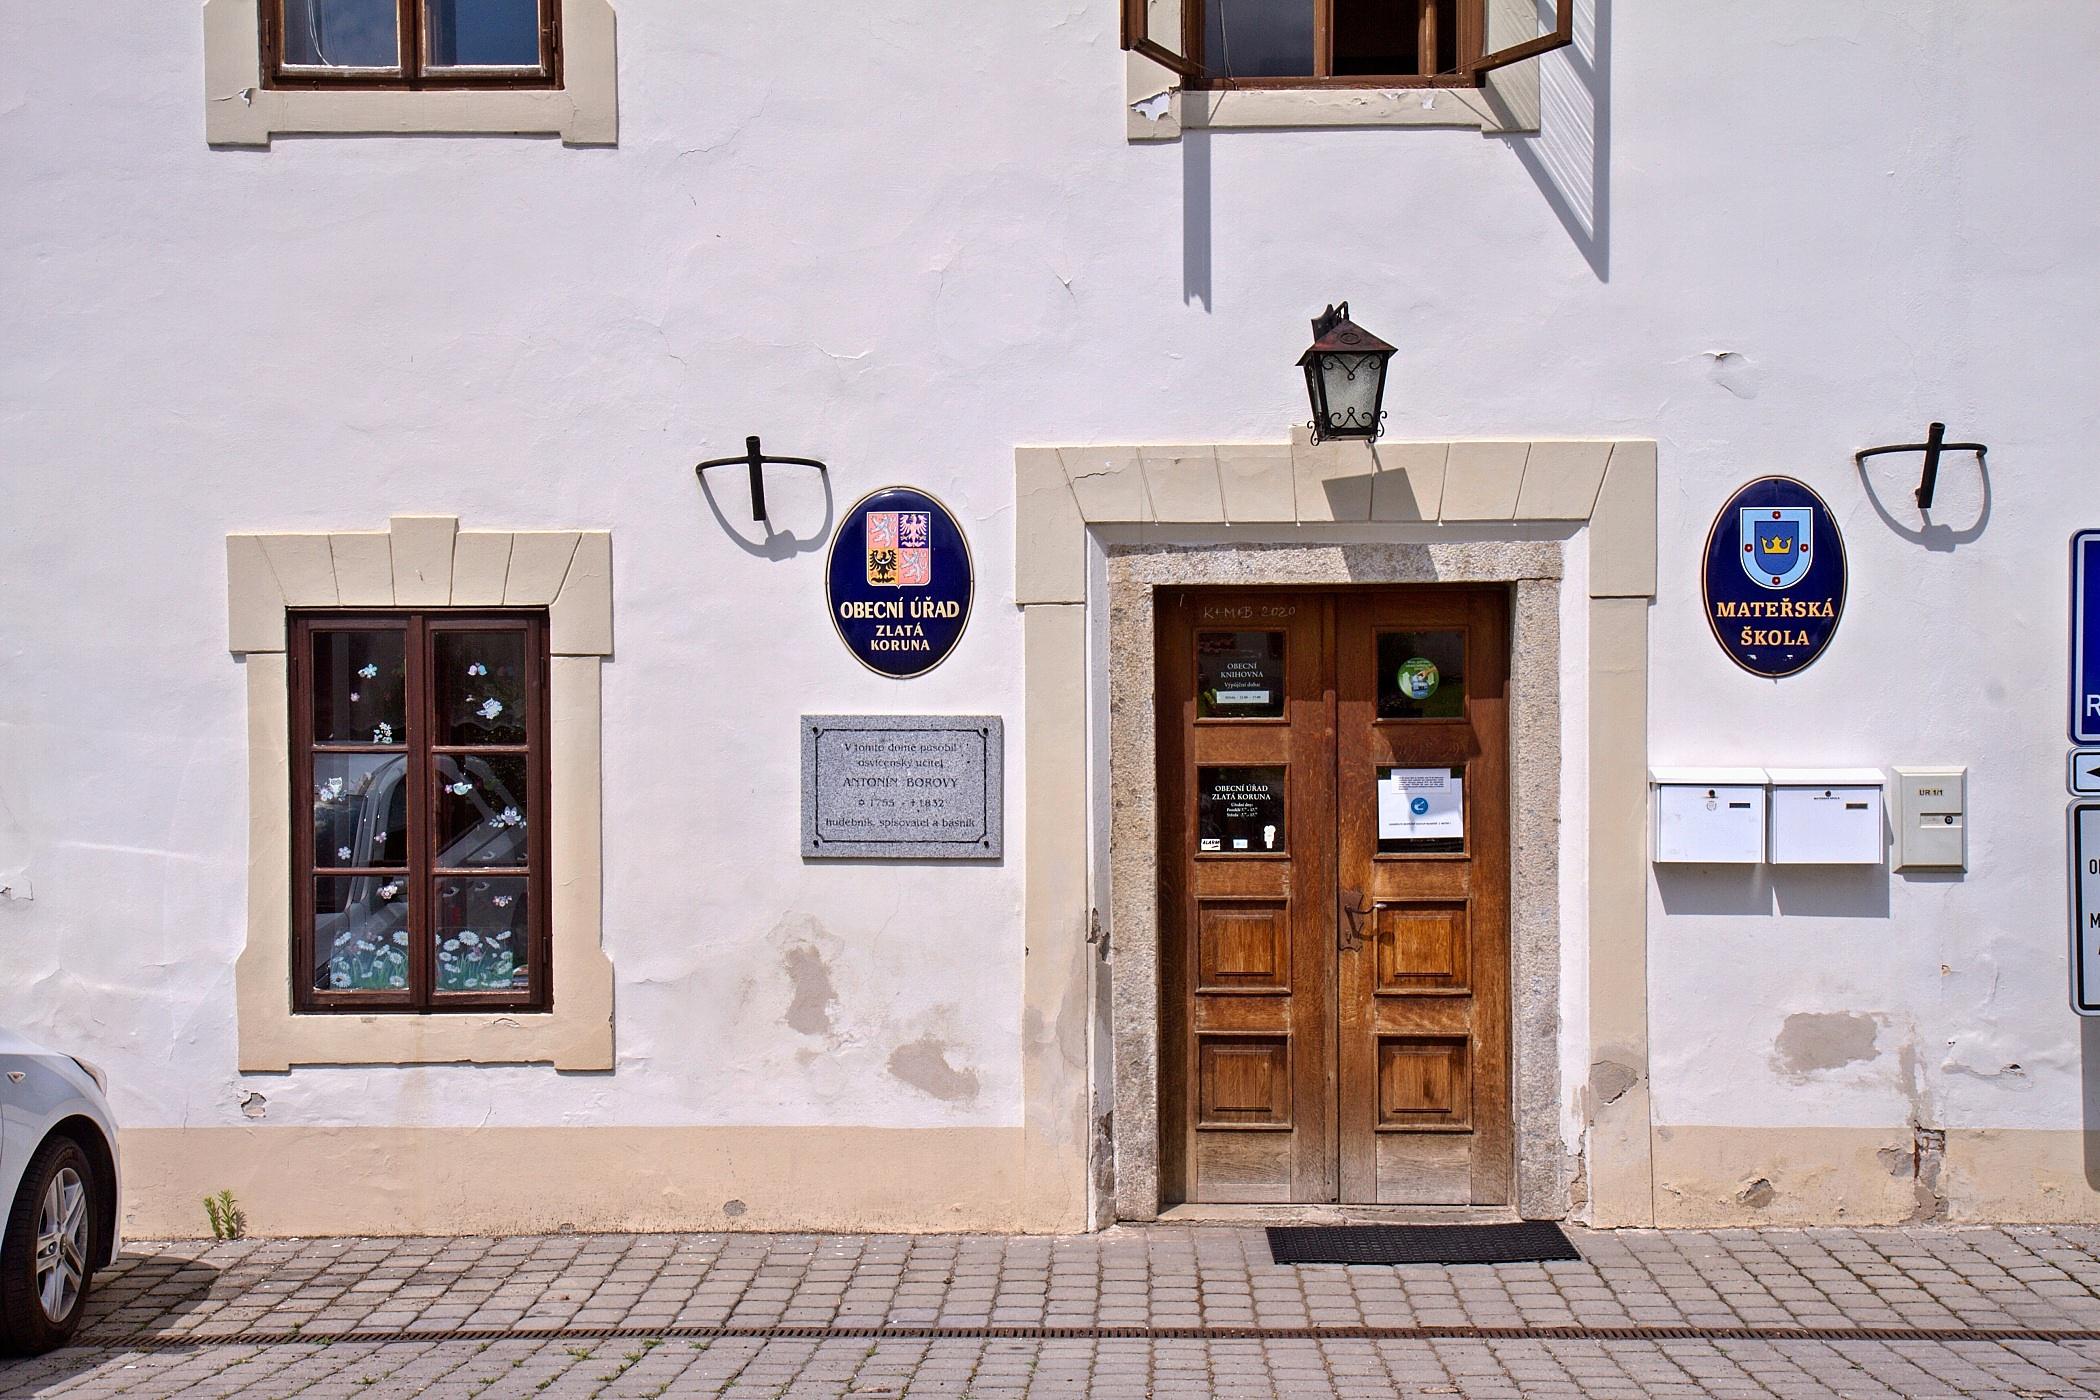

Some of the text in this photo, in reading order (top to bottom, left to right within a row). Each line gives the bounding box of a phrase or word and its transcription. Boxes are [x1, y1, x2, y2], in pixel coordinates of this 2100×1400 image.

[840, 596, 960, 619] OBECNÍ ÚŘAD
[1261, 606, 1296, 617] 2020
[1716, 598, 1834, 617] MATEŘSKÁ
[876, 622, 923, 637] ZLATÁ
[1741, 626, 1809, 646] ŠKOLA
[871, 639, 930, 651] KORUNA
[1227, 662, 1257, 670] OBECNÍ
[844, 743, 852, 751] V
[843, 775, 898, 787] ANTONÍN
[1214, 784, 1268, 792] OBECNÍ ÚŘAD
[919, 799, 945, 807] 1832
[2089, 859, 2100, 874] O
